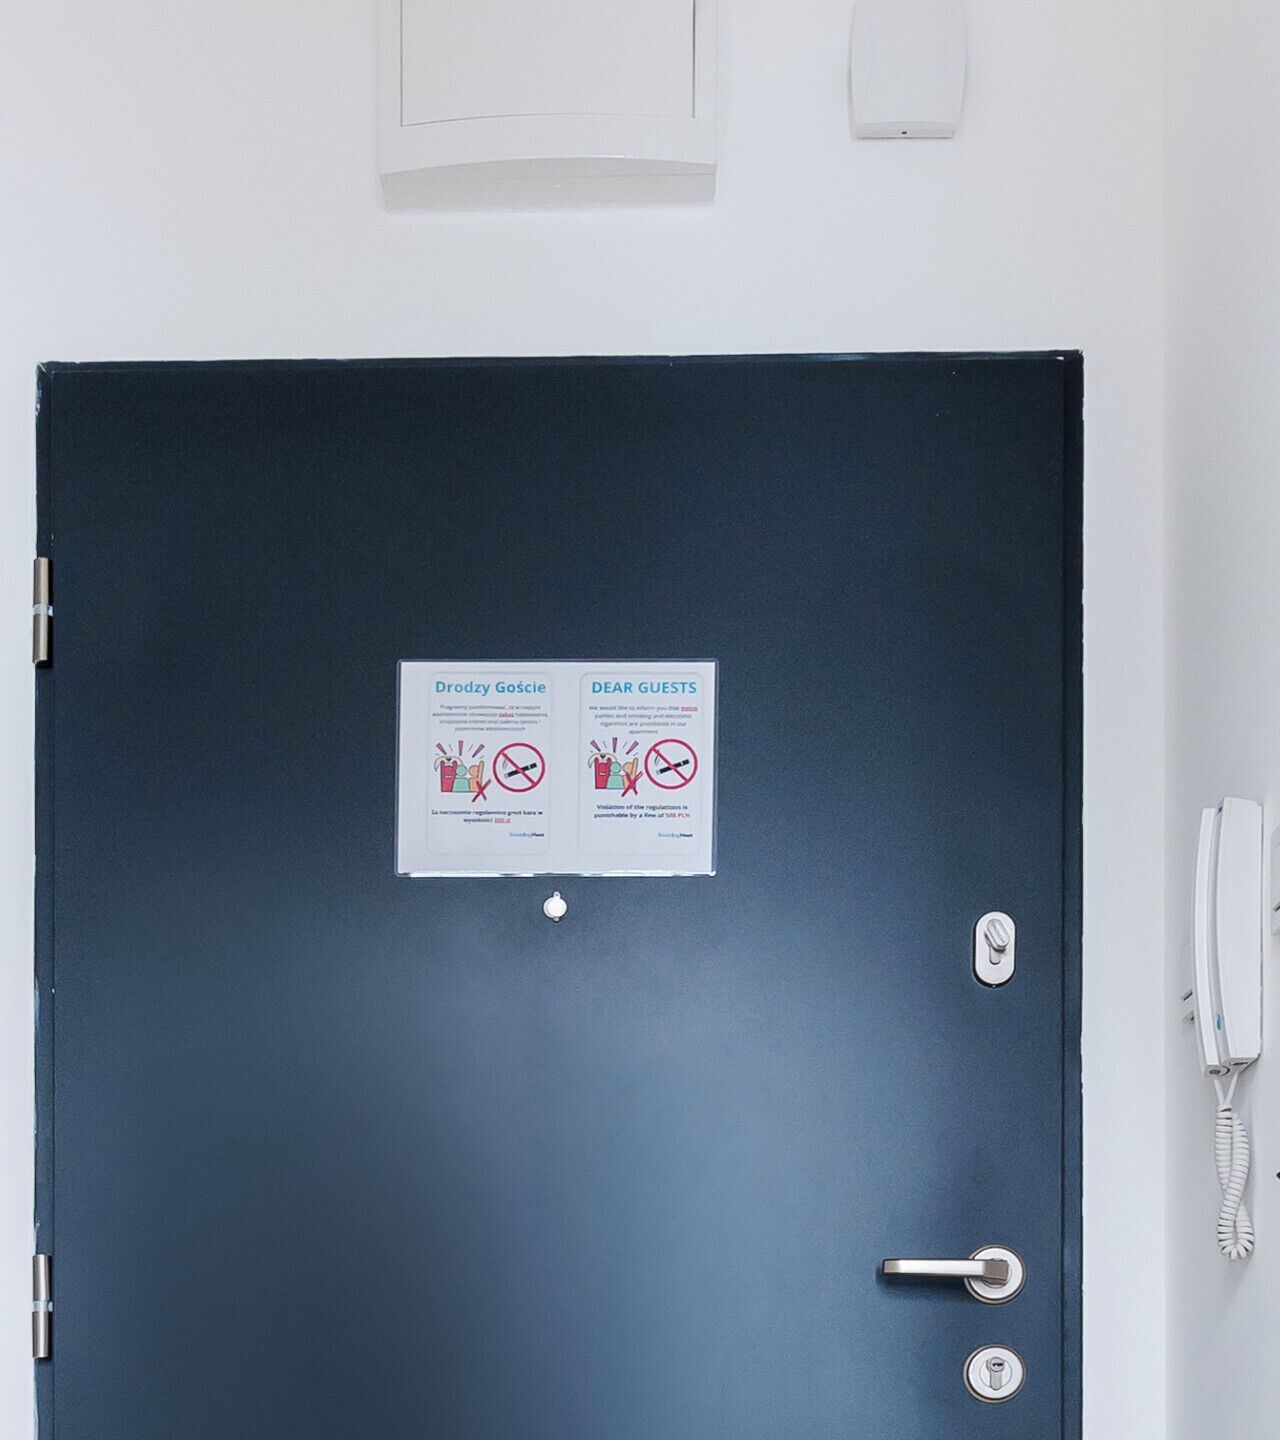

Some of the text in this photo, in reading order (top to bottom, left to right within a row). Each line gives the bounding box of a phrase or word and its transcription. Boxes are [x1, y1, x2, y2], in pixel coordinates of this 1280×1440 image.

[435, 680, 546, 696] Drodzy Goście
[592, 681, 697, 694] DEAR GUESTS
